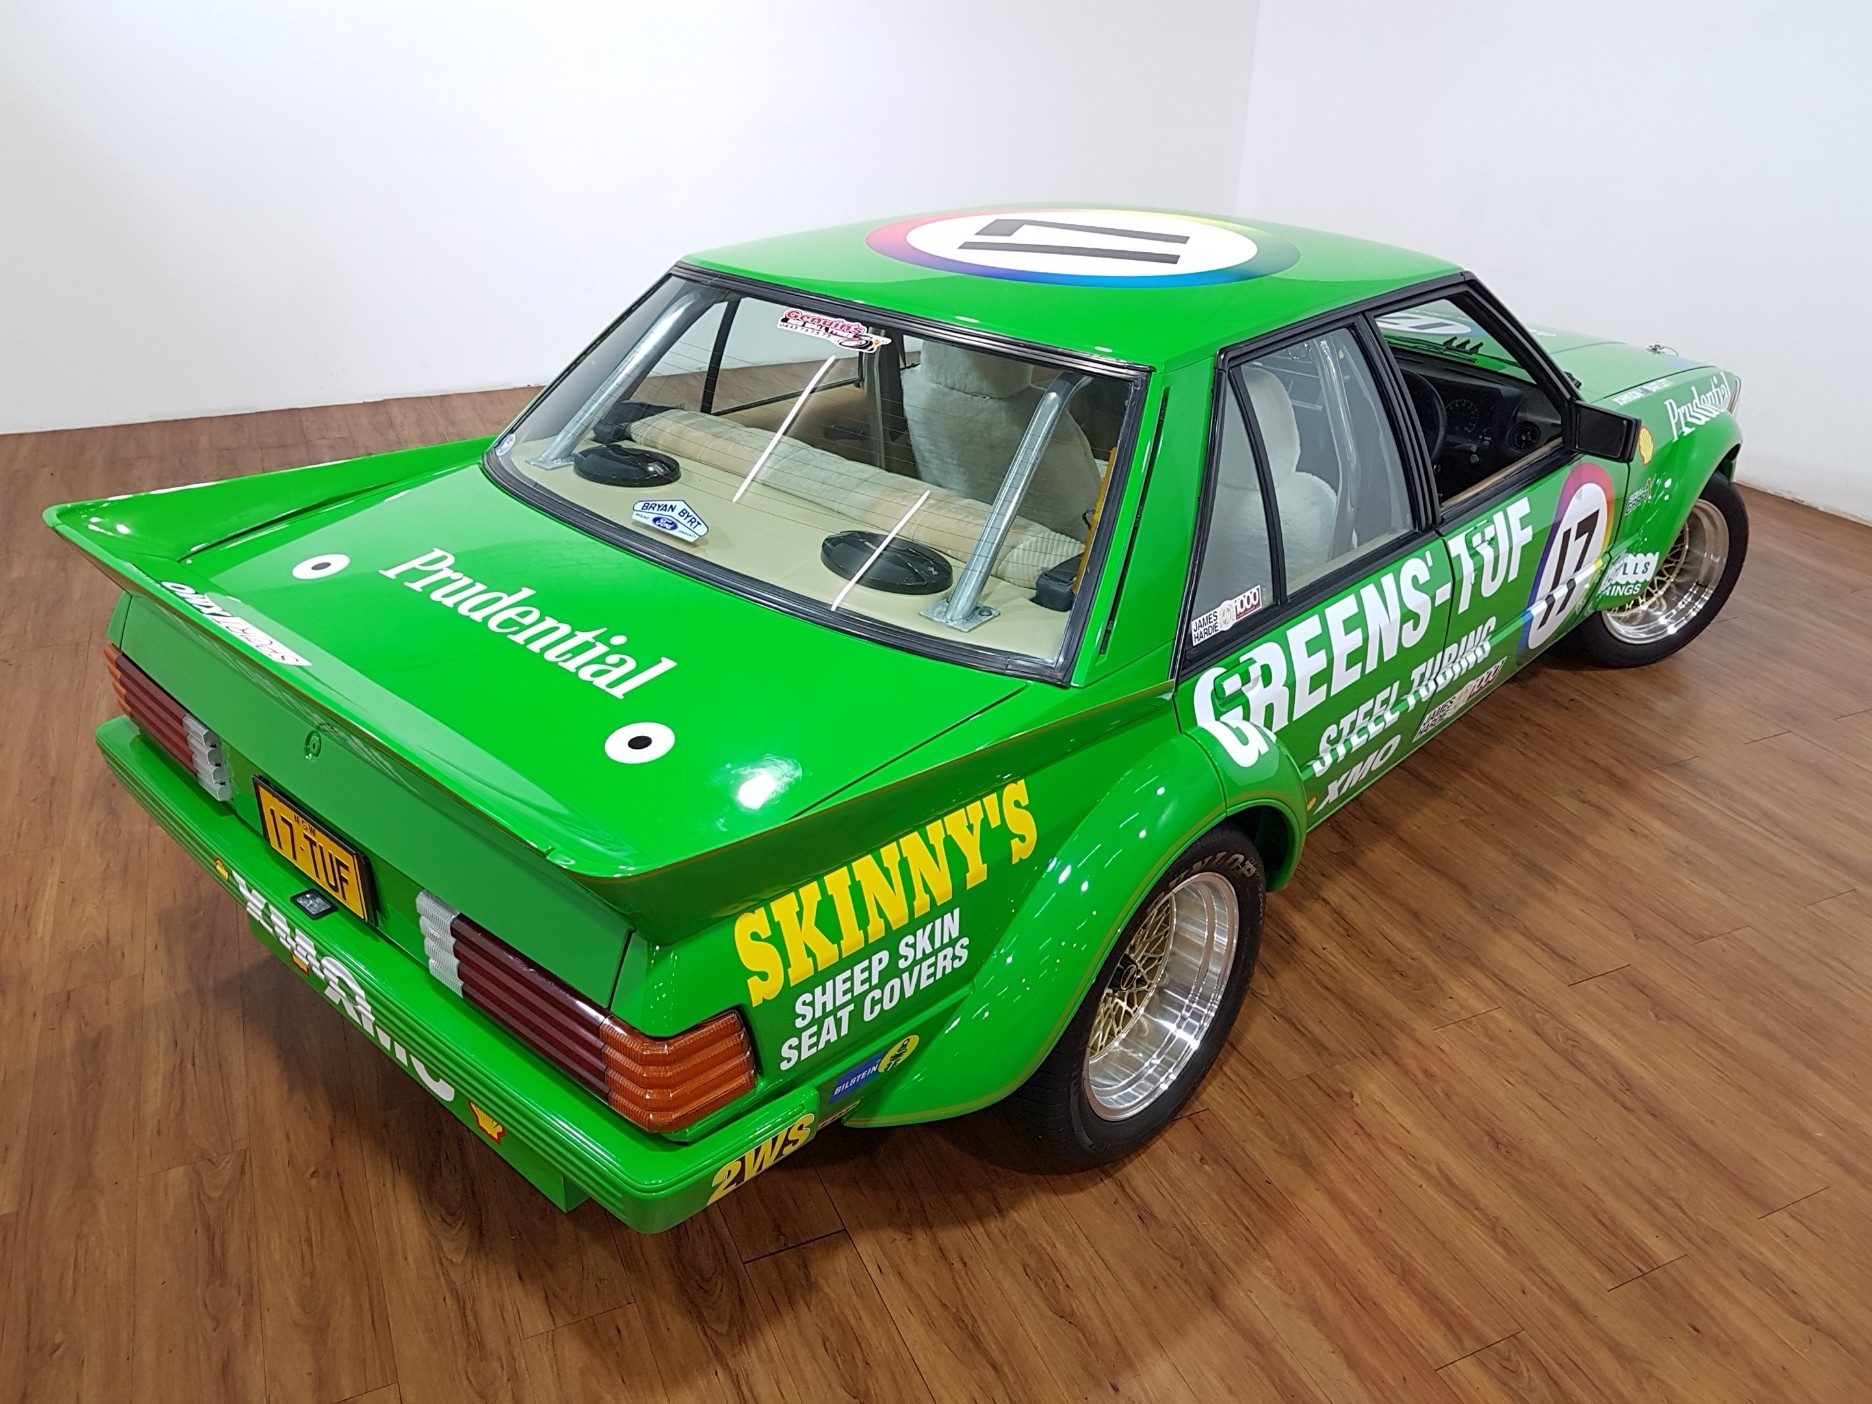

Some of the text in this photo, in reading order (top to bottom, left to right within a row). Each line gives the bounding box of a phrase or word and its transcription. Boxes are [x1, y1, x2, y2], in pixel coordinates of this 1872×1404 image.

[957, 218, 1190, 265] 17
[641, 502, 702, 530] BRYAN BYRT
[1235, 587, 1259, 615] 1000
[1537, 508, 1601, 632] 17
[378, 547, 679, 700] Prudential
[1193, 611, 1218, 633] JAMES
[1193, 621, 1219, 644] HARDIE
[1308, 616, 1497, 777] STEEL TUBING
[1314, 735, 1401, 816] XMO
[734, 779, 1038, 1008] SKINNY'S
[779, 937, 970, 1072] SEAT COVERS
[795, 907, 960, 1029] SHEEP SKIN
[833, 1063, 879, 1096] BILSTEIN
[706, 1113, 815, 1207] 2WS
